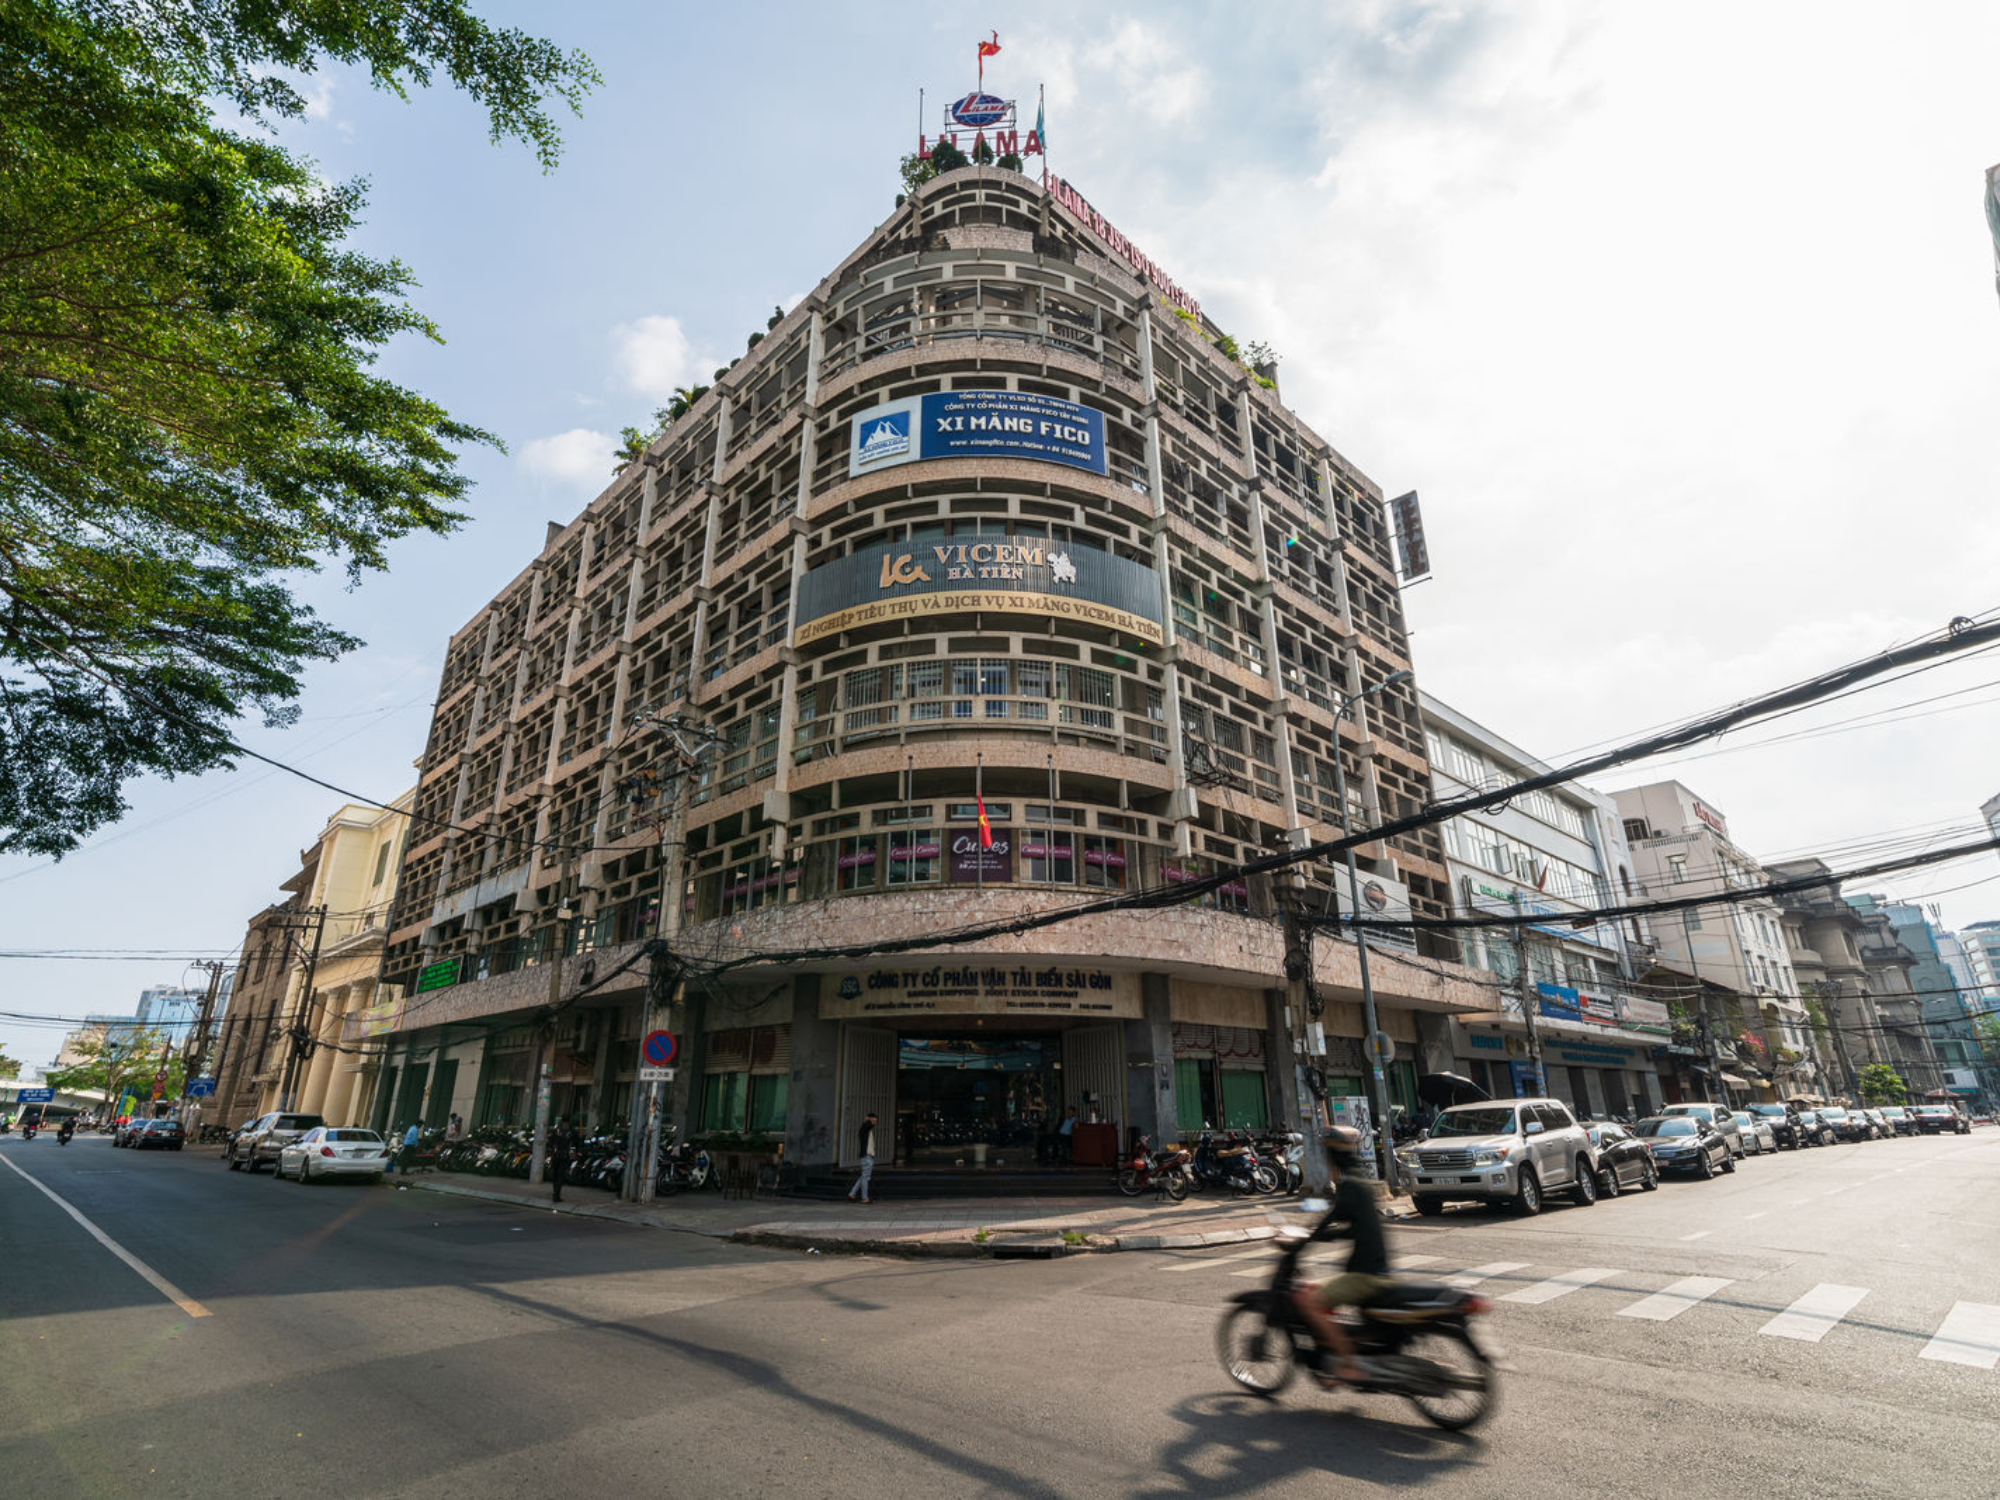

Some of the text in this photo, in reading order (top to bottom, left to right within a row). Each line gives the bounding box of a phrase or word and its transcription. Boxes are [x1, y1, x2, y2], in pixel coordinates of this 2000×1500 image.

[960, 94, 1006, 113] LILAMA
[1044, 167, 1092, 228] LILAMA
[1092, 211, 1106, 240] 18
[1108, 224, 1129, 259] JSC
[1129, 242, 1149, 276] ISO
[1042, 408, 1058, 417] FICO
[936, 412, 1090, 446] XI MĂNG FICO
[932, 544, 1044, 566] VICEM
[948, 563, 1024, 580] HÀ TIÊN
[812, 612, 855, 636] NGHIỆP
[857, 605, 886, 621] TIÊU
[888, 600, 918, 614] THỤ
[921, 594, 942, 609] VÀ
[944, 595, 981, 610] DỊCH
[984, 595, 1005, 610] VỤ
[1008, 596, 1024, 608] XI
[1028, 596, 1070, 614] MĂNG
[1073, 604, 1116, 624] VICEM
[1118, 615, 1135, 629] HÀ
[1136, 620, 1160, 640] TIÊN
[868, 966, 1112, 990] CÔNG TY CỔ PHẦN VẬN TẢI BIỂN SÀI GÒN
